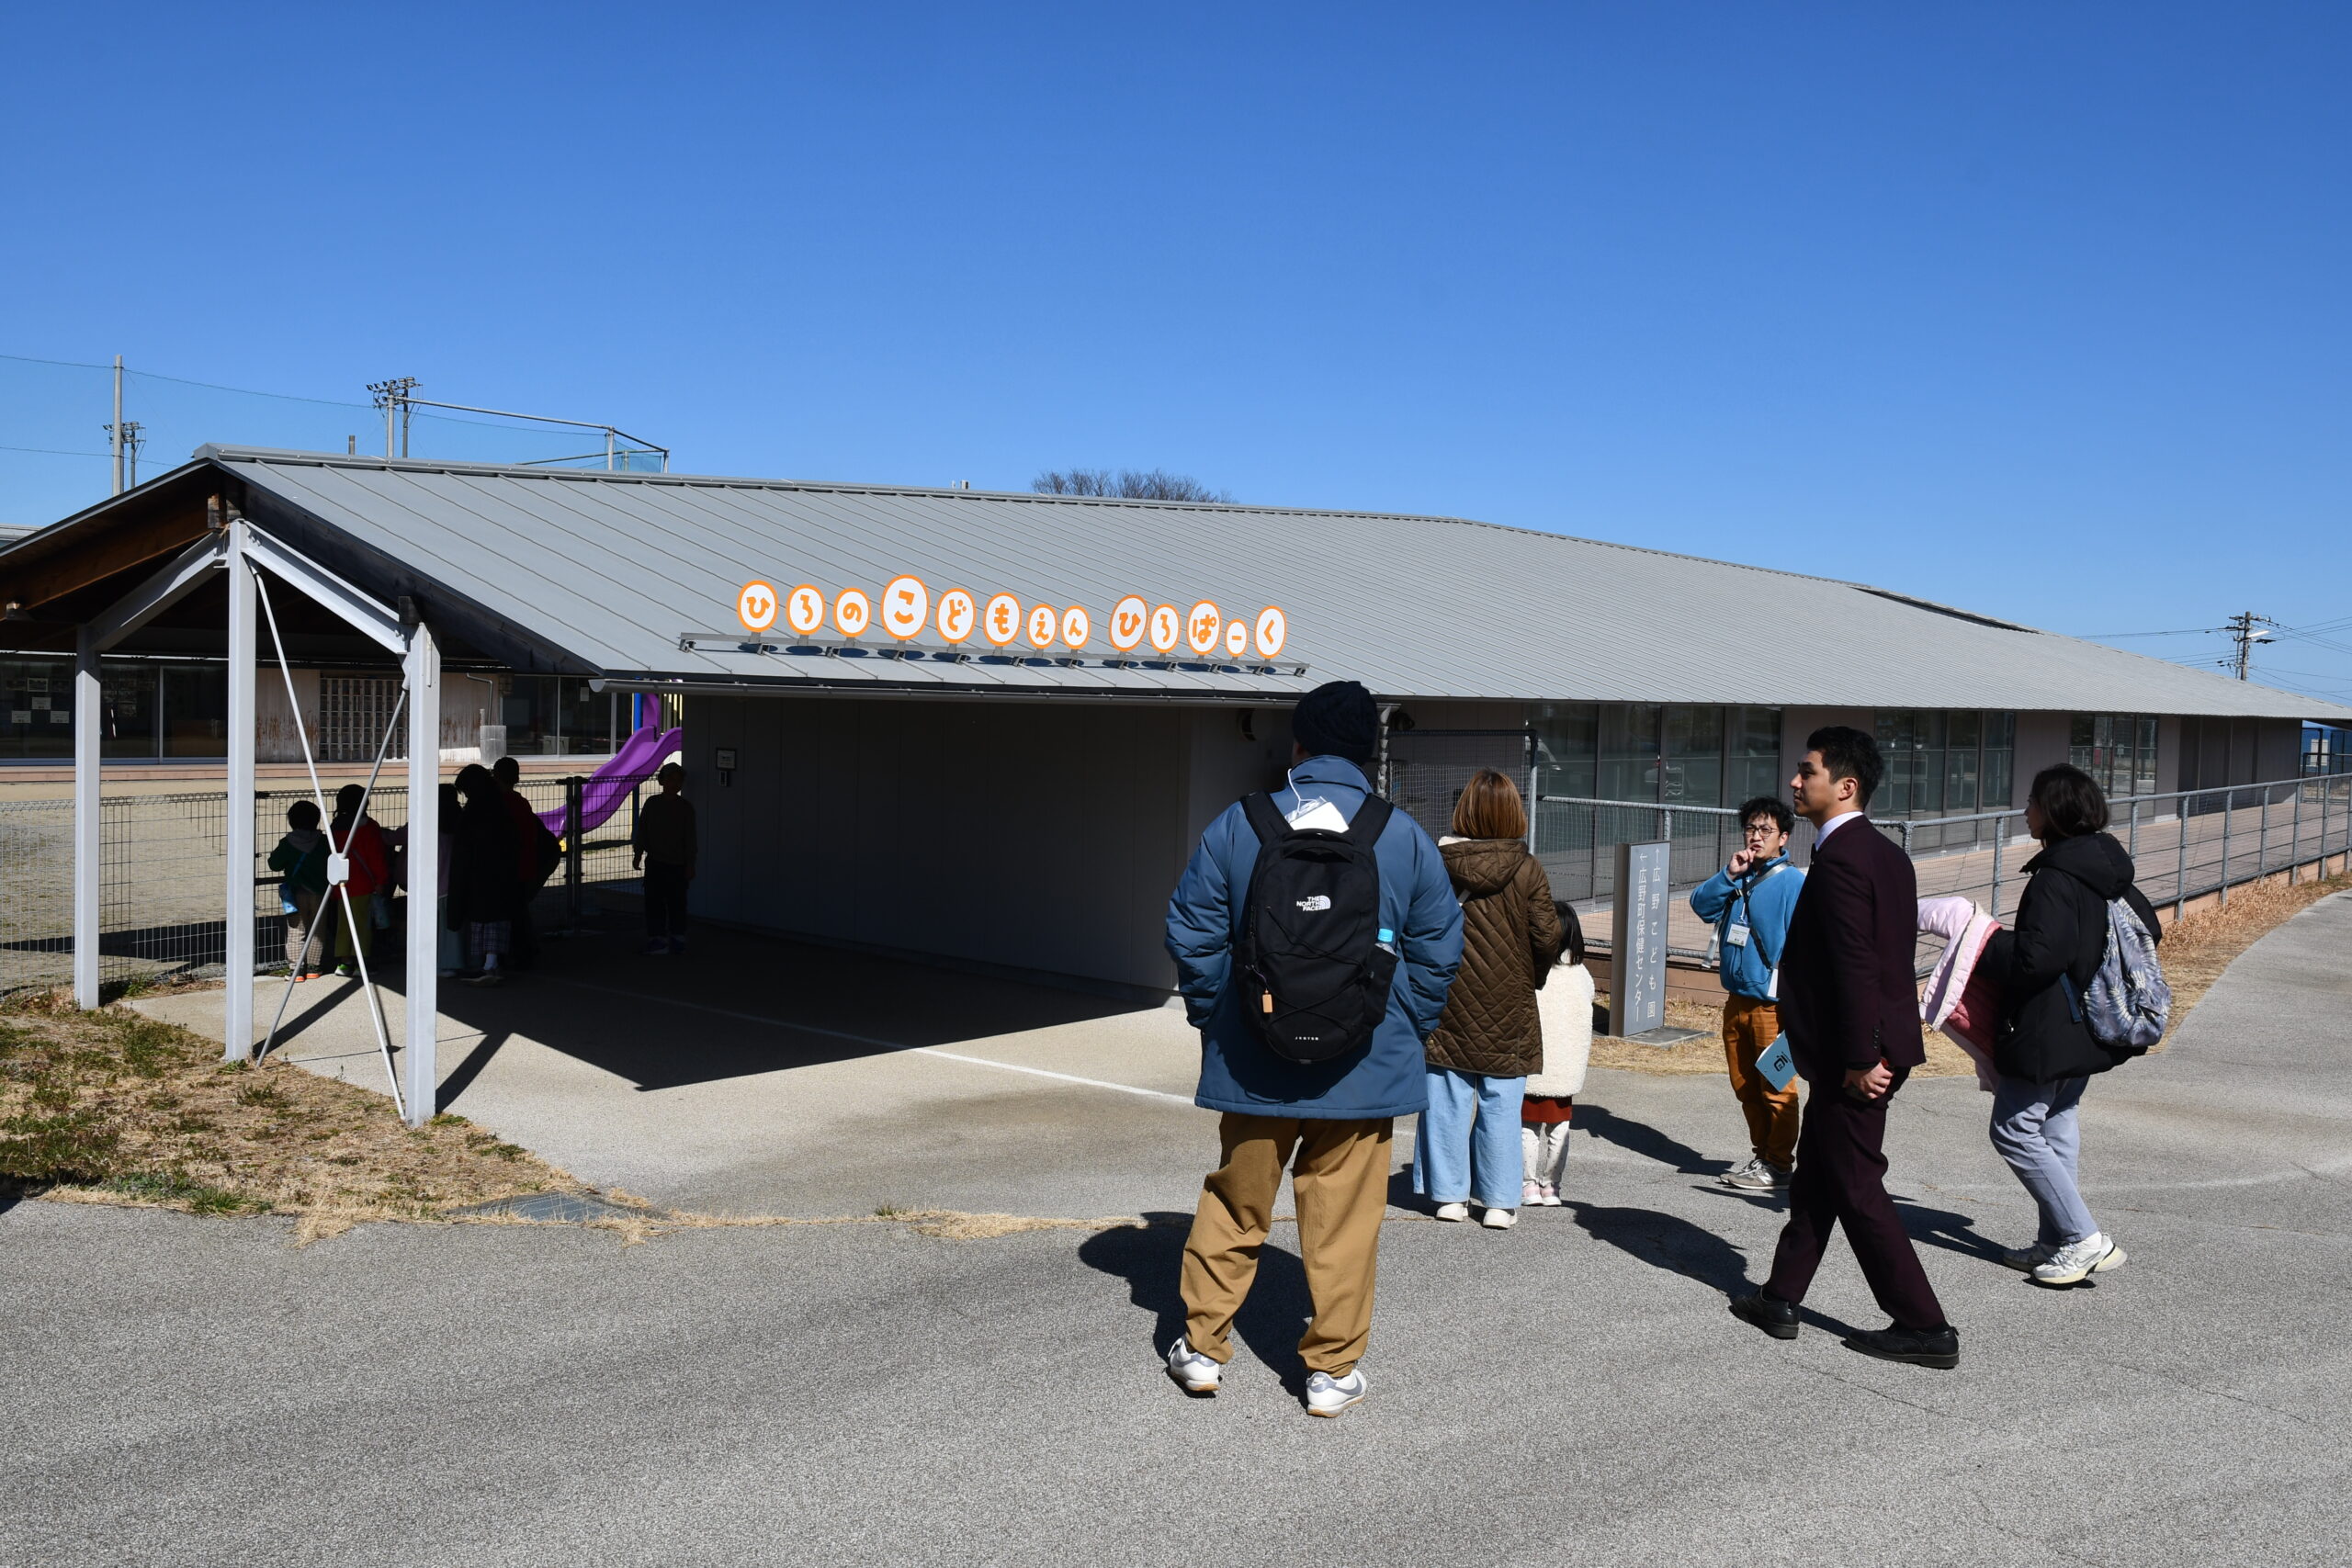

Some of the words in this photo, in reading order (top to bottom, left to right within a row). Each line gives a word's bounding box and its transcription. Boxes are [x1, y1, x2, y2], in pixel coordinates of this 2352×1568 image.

[746, 590, 1082, 641] ひろのこどもえん
[1117, 610, 1277, 647] ひろぱーく
[1635, 867, 1647, 1022] 広野町保健センター
[1646, 865, 1661, 1019] 広野こども園
